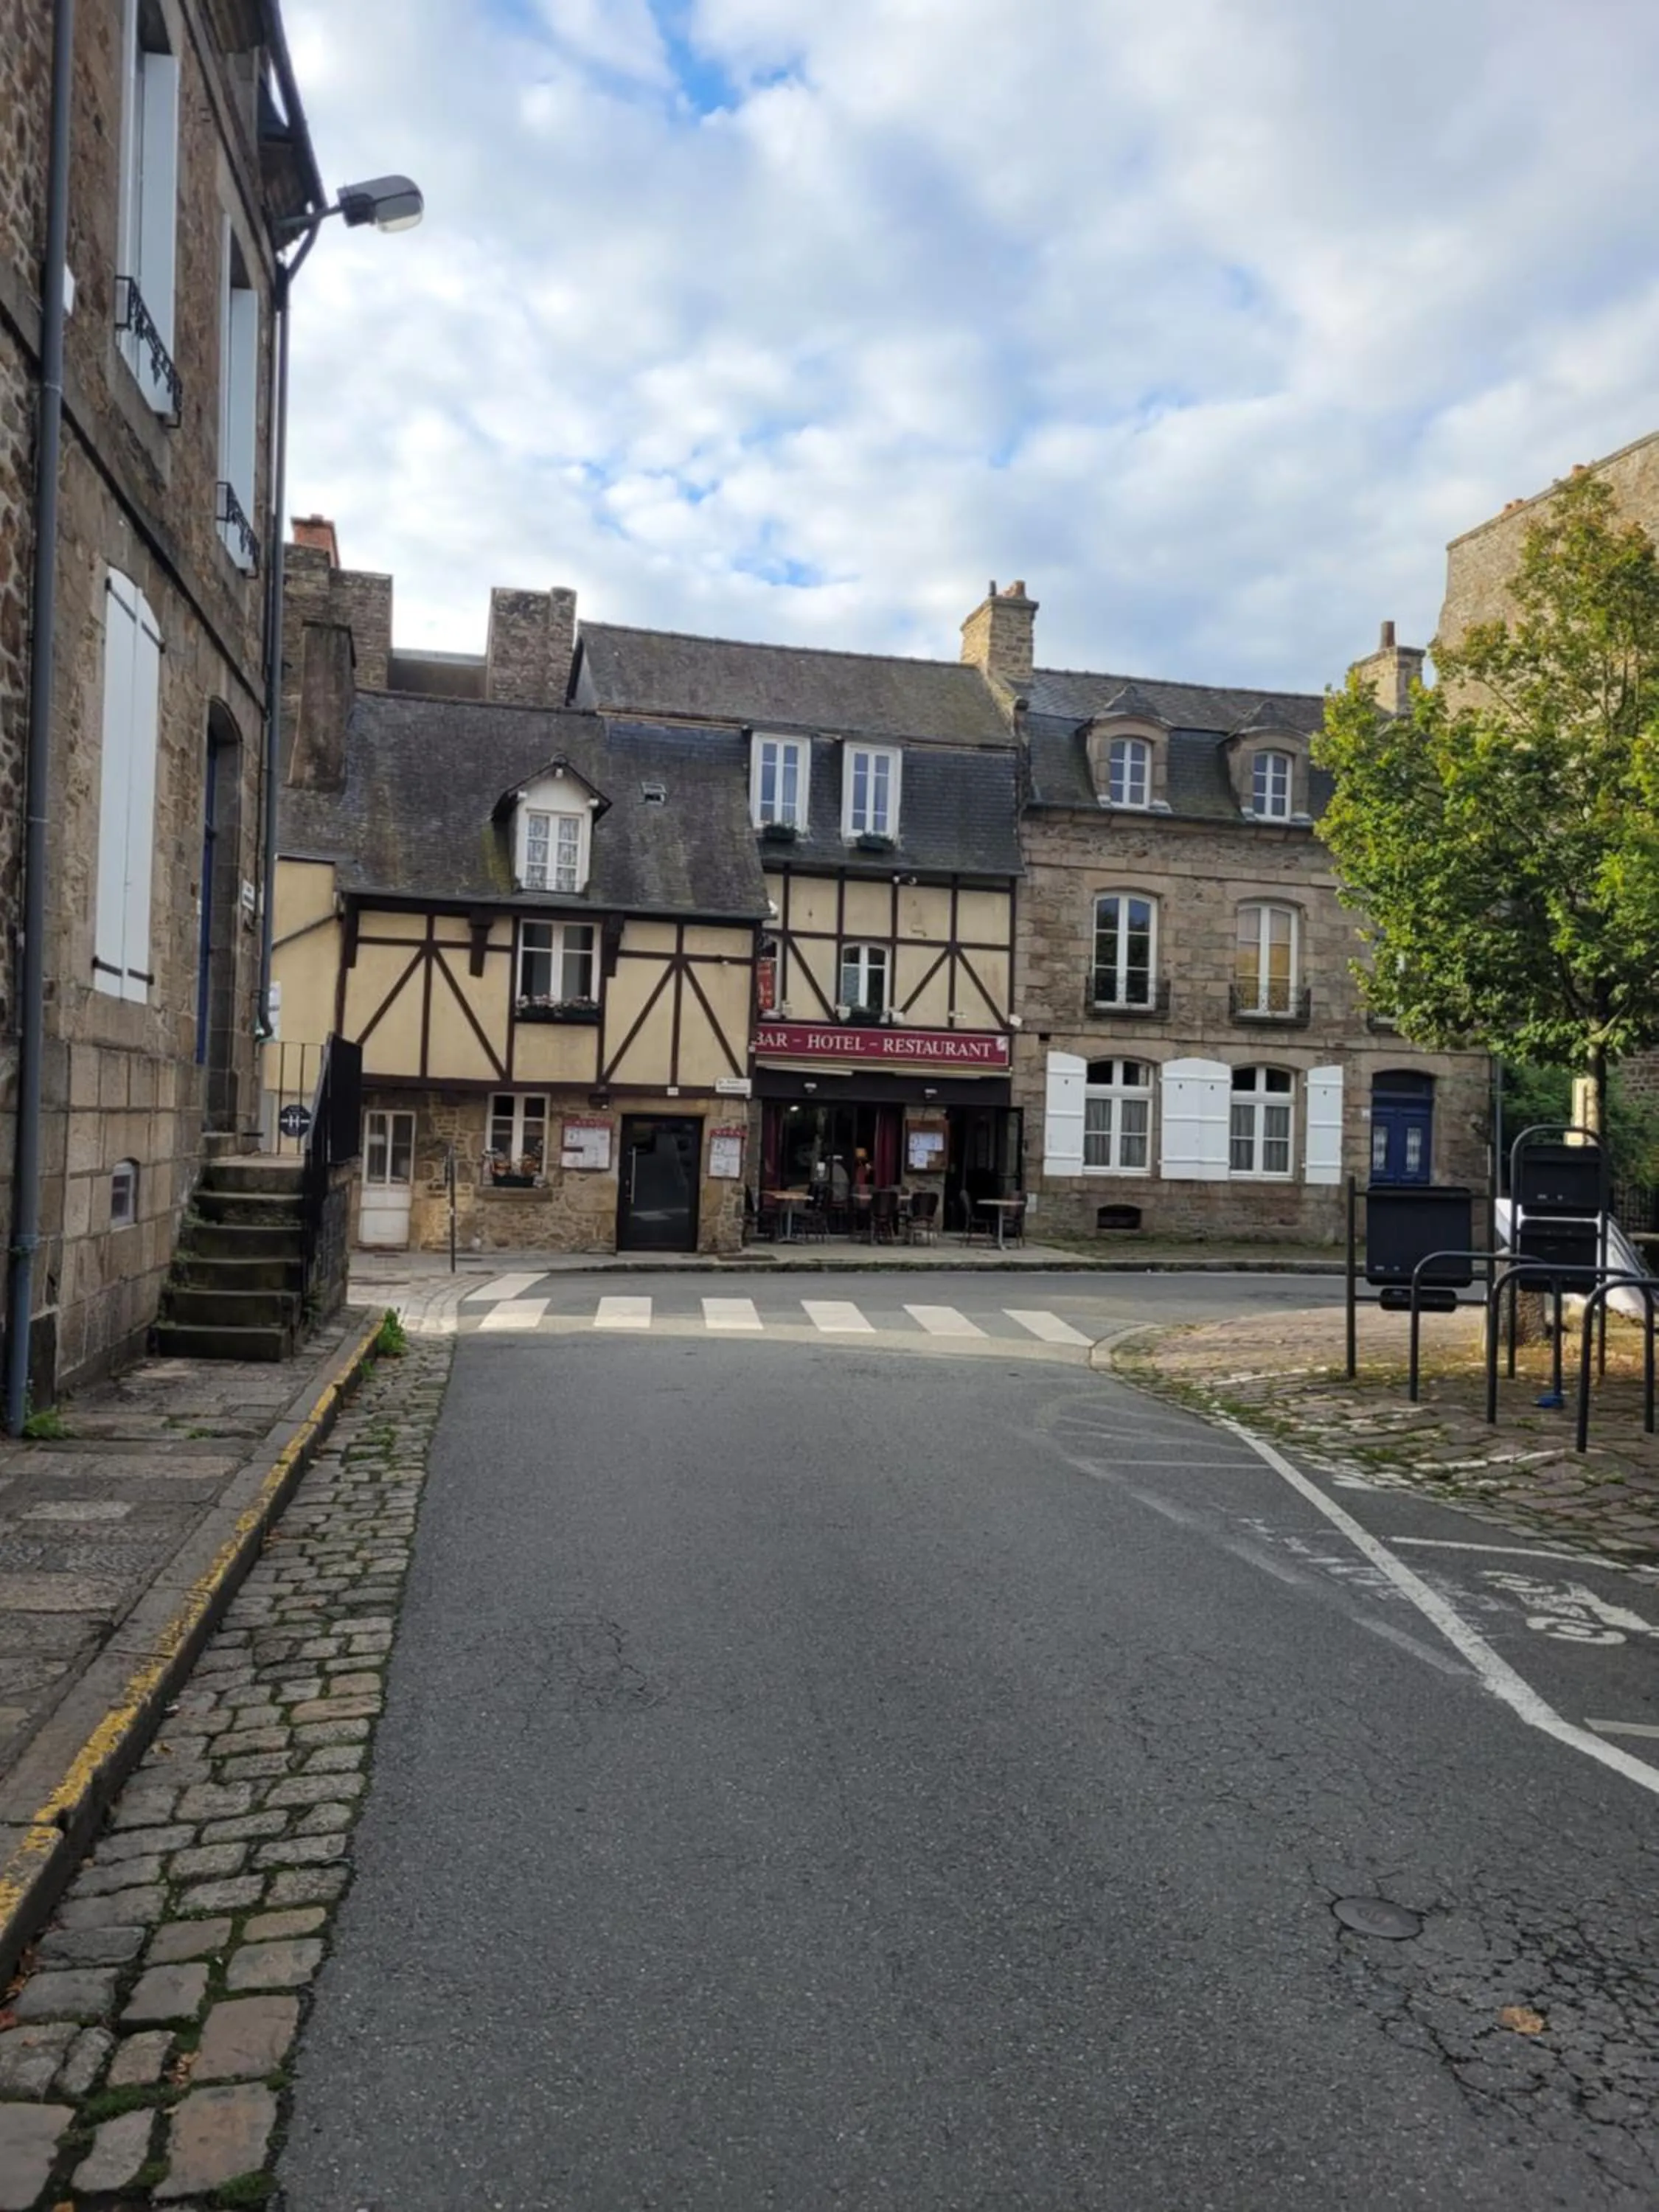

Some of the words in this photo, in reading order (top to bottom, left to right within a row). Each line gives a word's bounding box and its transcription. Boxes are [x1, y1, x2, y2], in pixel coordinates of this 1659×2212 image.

[756, 1031, 788, 1048] BAR
[807, 1033, 866, 1051] HOTEL
[883, 1037, 991, 1057] RESTAURANT
